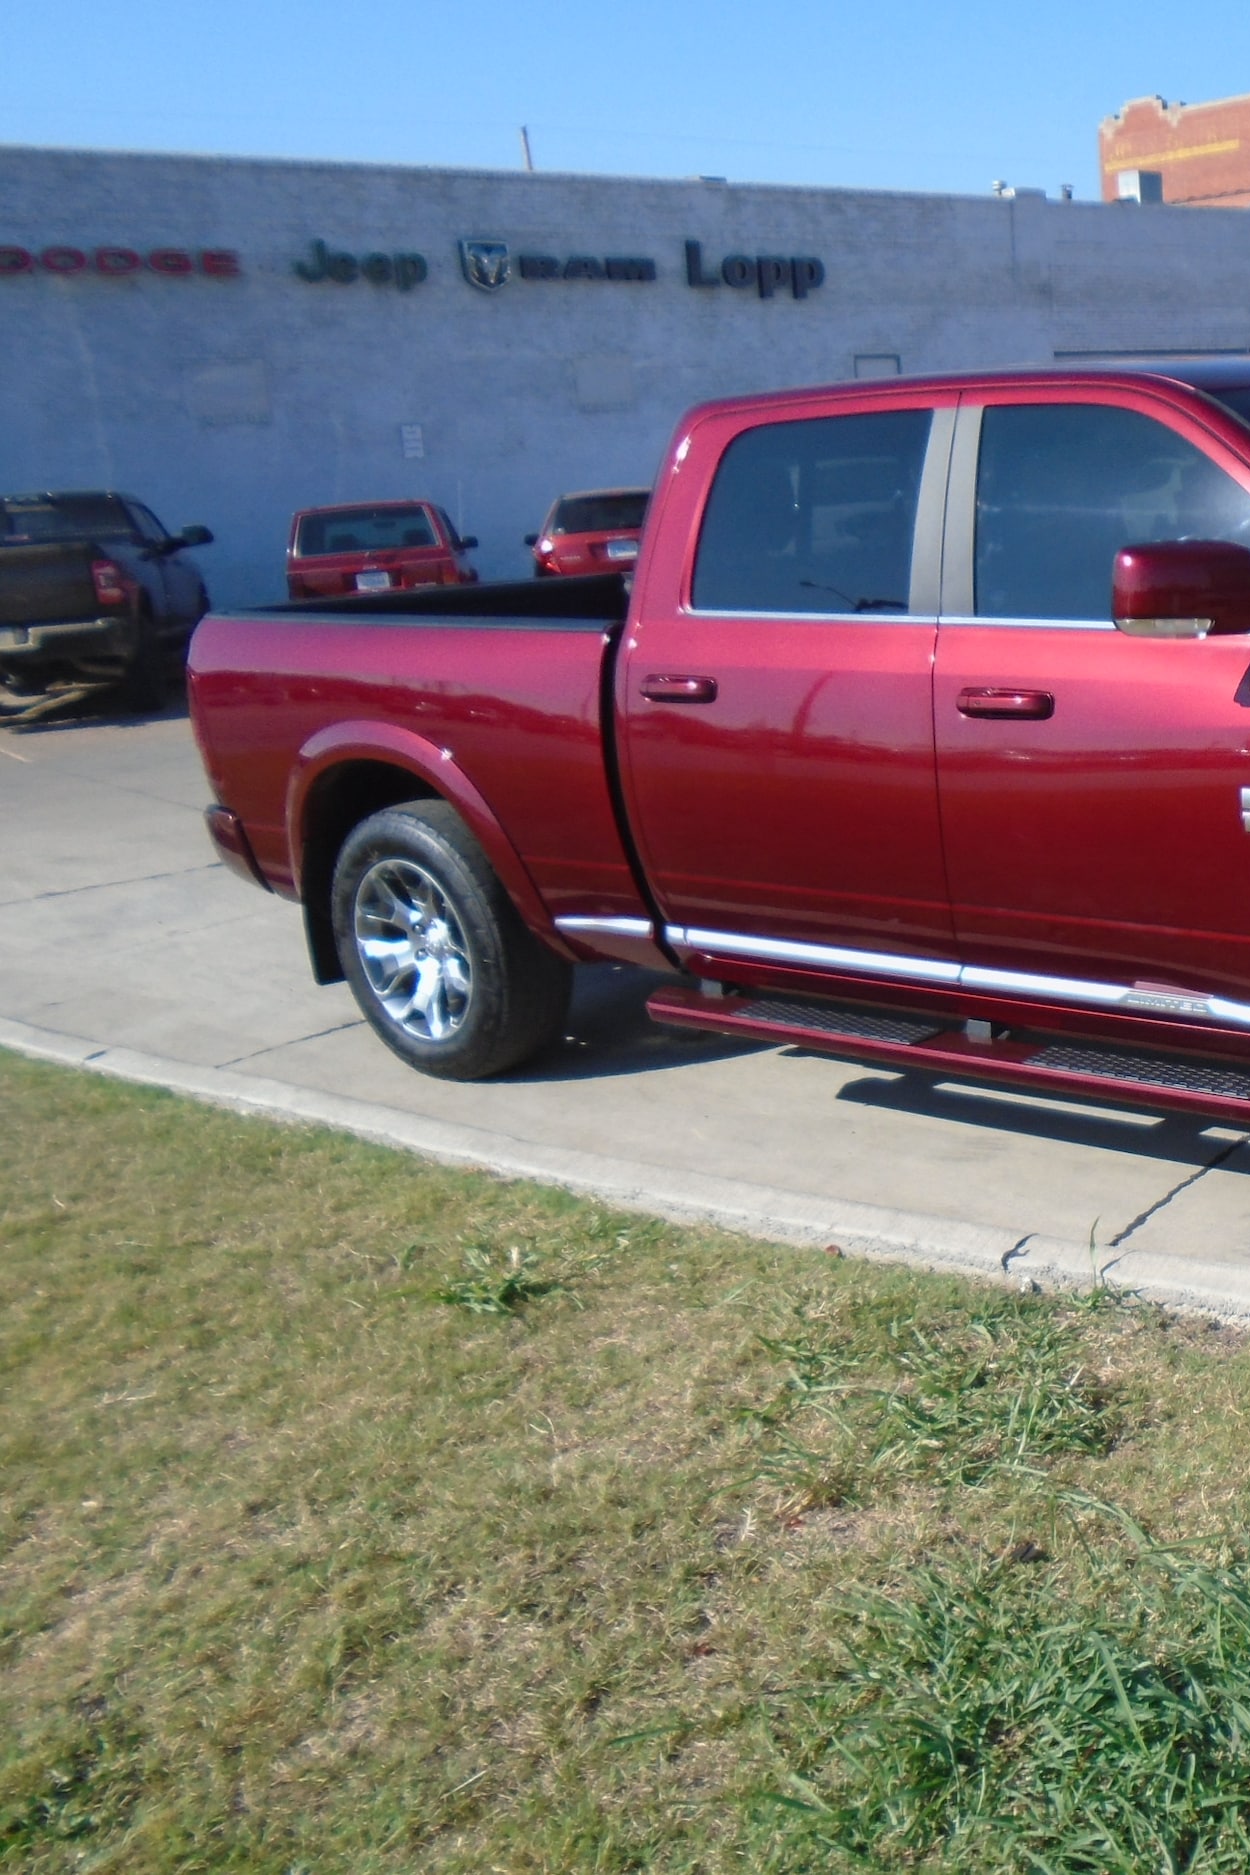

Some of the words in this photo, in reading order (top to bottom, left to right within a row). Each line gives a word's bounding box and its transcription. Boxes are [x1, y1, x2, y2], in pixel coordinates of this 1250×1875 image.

[0, 246, 237, 275] DODGE
[294, 238, 427, 292] Jeep
[520, 255, 656, 281] RAM
[685, 239, 825, 299] Lopp
